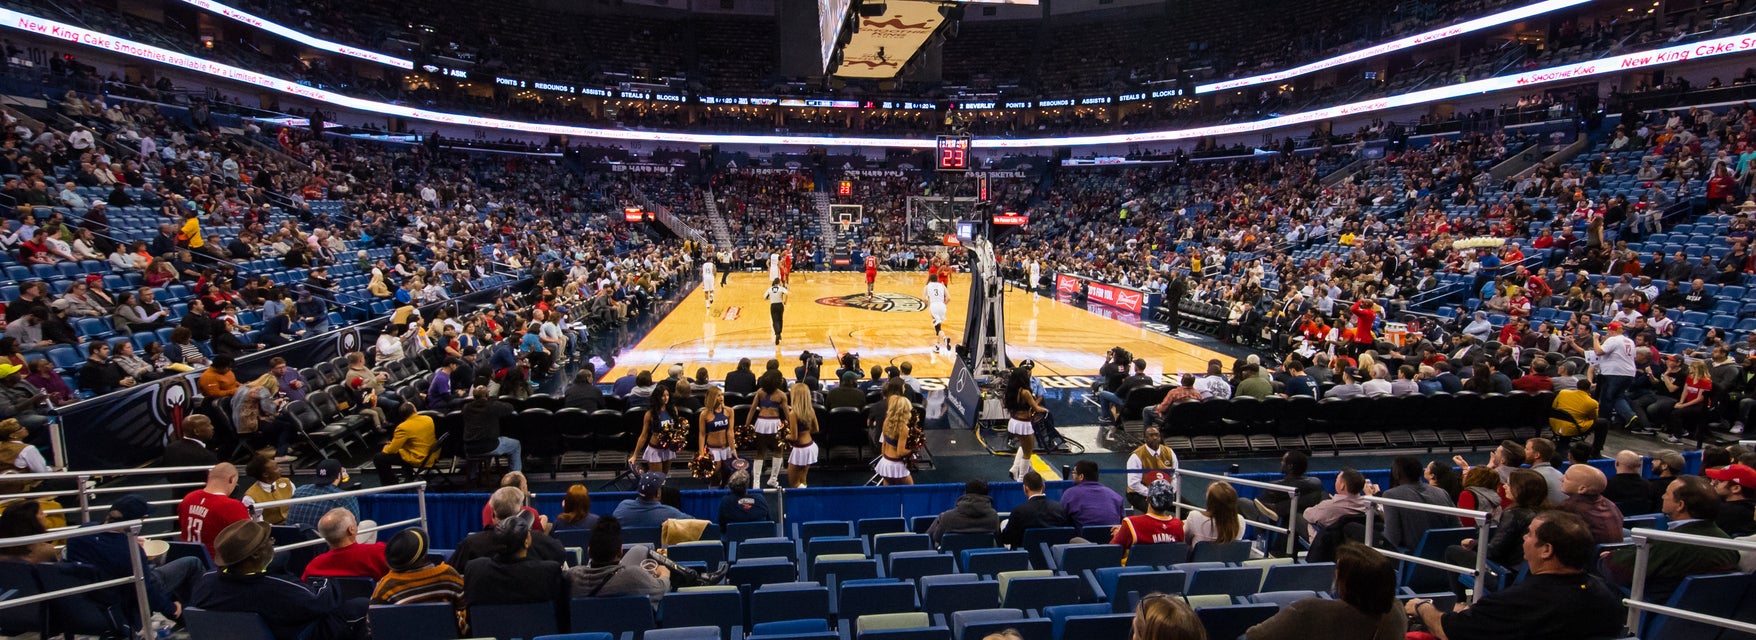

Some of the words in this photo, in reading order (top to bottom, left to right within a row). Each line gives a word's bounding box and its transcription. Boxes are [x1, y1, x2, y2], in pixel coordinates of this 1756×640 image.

[18, 18, 47, 32] New
[52, 26, 79, 42] King
[84, 34, 110, 48] Cake
[114, 41, 166, 60] Smoothies
[169, 56, 206, 70] available
[230, 70, 256, 82] Limited
[1621, 56, 1652, 68] New
[1656, 50, 1690, 62] King
[1696, 43, 1734, 56] Cake
[451, 70, 466, 78] ASIK
[1531, 70, 1571, 82] SMOOTHIE
[1573, 66, 1595, 75] KING
[496, 78, 517, 86] POINTS
[535, 83, 568, 92] REBOUNDS
[943, 150, 964, 166] 23
[714, 419, 728, 427] PELS
[189, 505, 208, 518] HARDEN
[188, 517, 203, 544] 13
